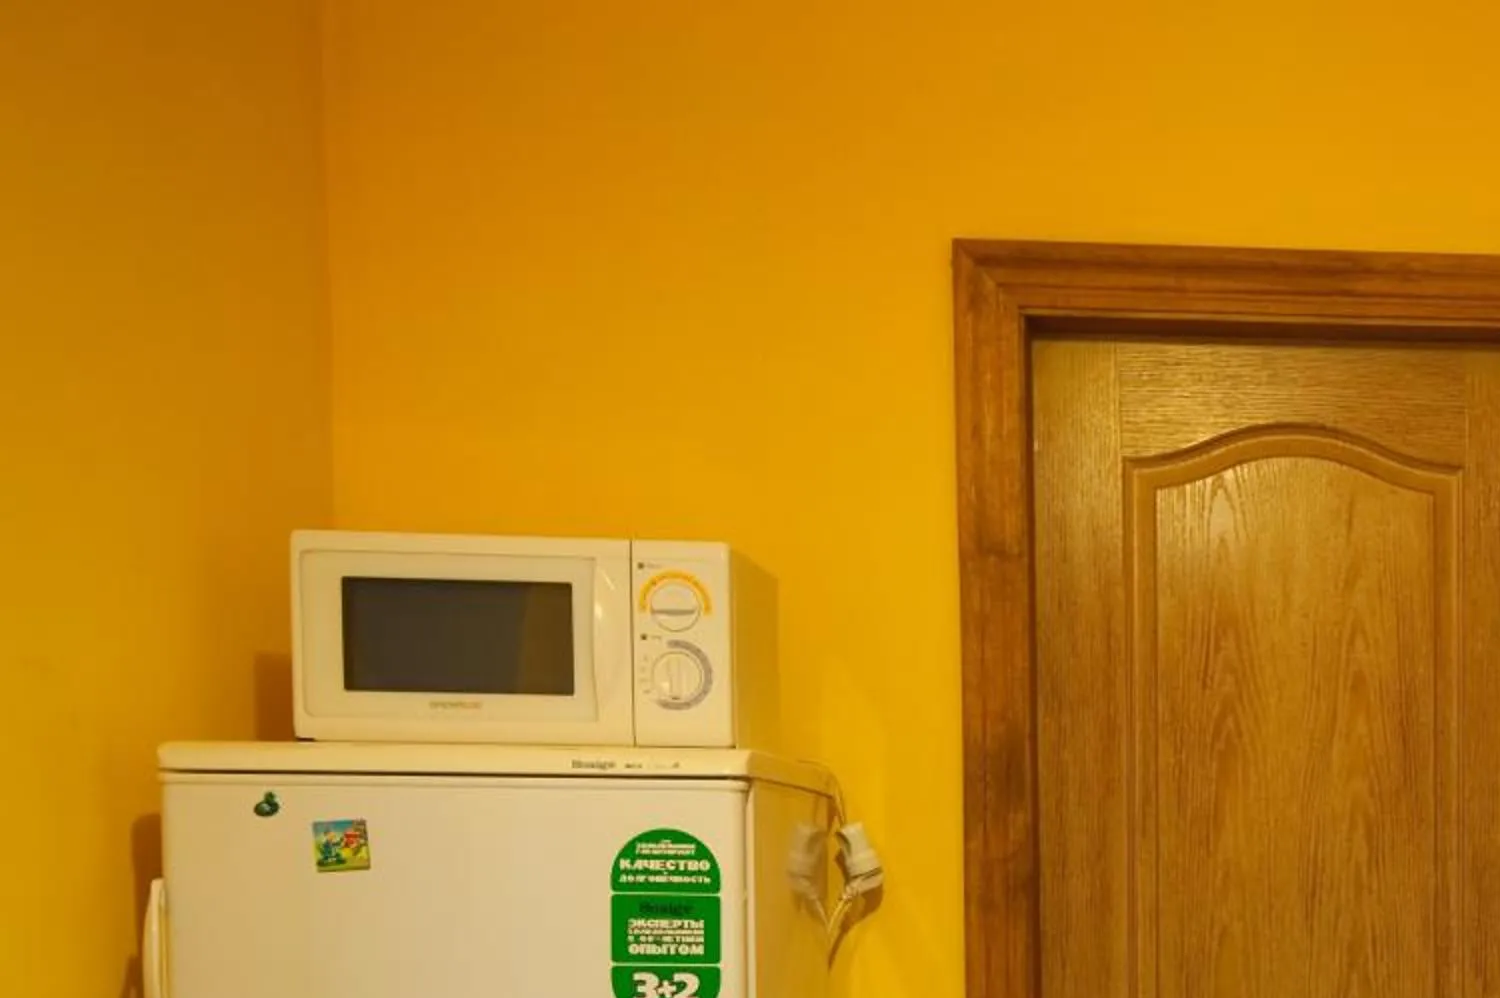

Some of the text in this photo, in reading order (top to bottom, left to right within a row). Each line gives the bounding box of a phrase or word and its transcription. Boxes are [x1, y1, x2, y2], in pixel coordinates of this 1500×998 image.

[619, 858, 711, 871] КАЧЕСТВО
[627, 919, 705, 929] ЭКСПЕРТЫ
[627, 943, 705, 955] ОПЫТОМ
